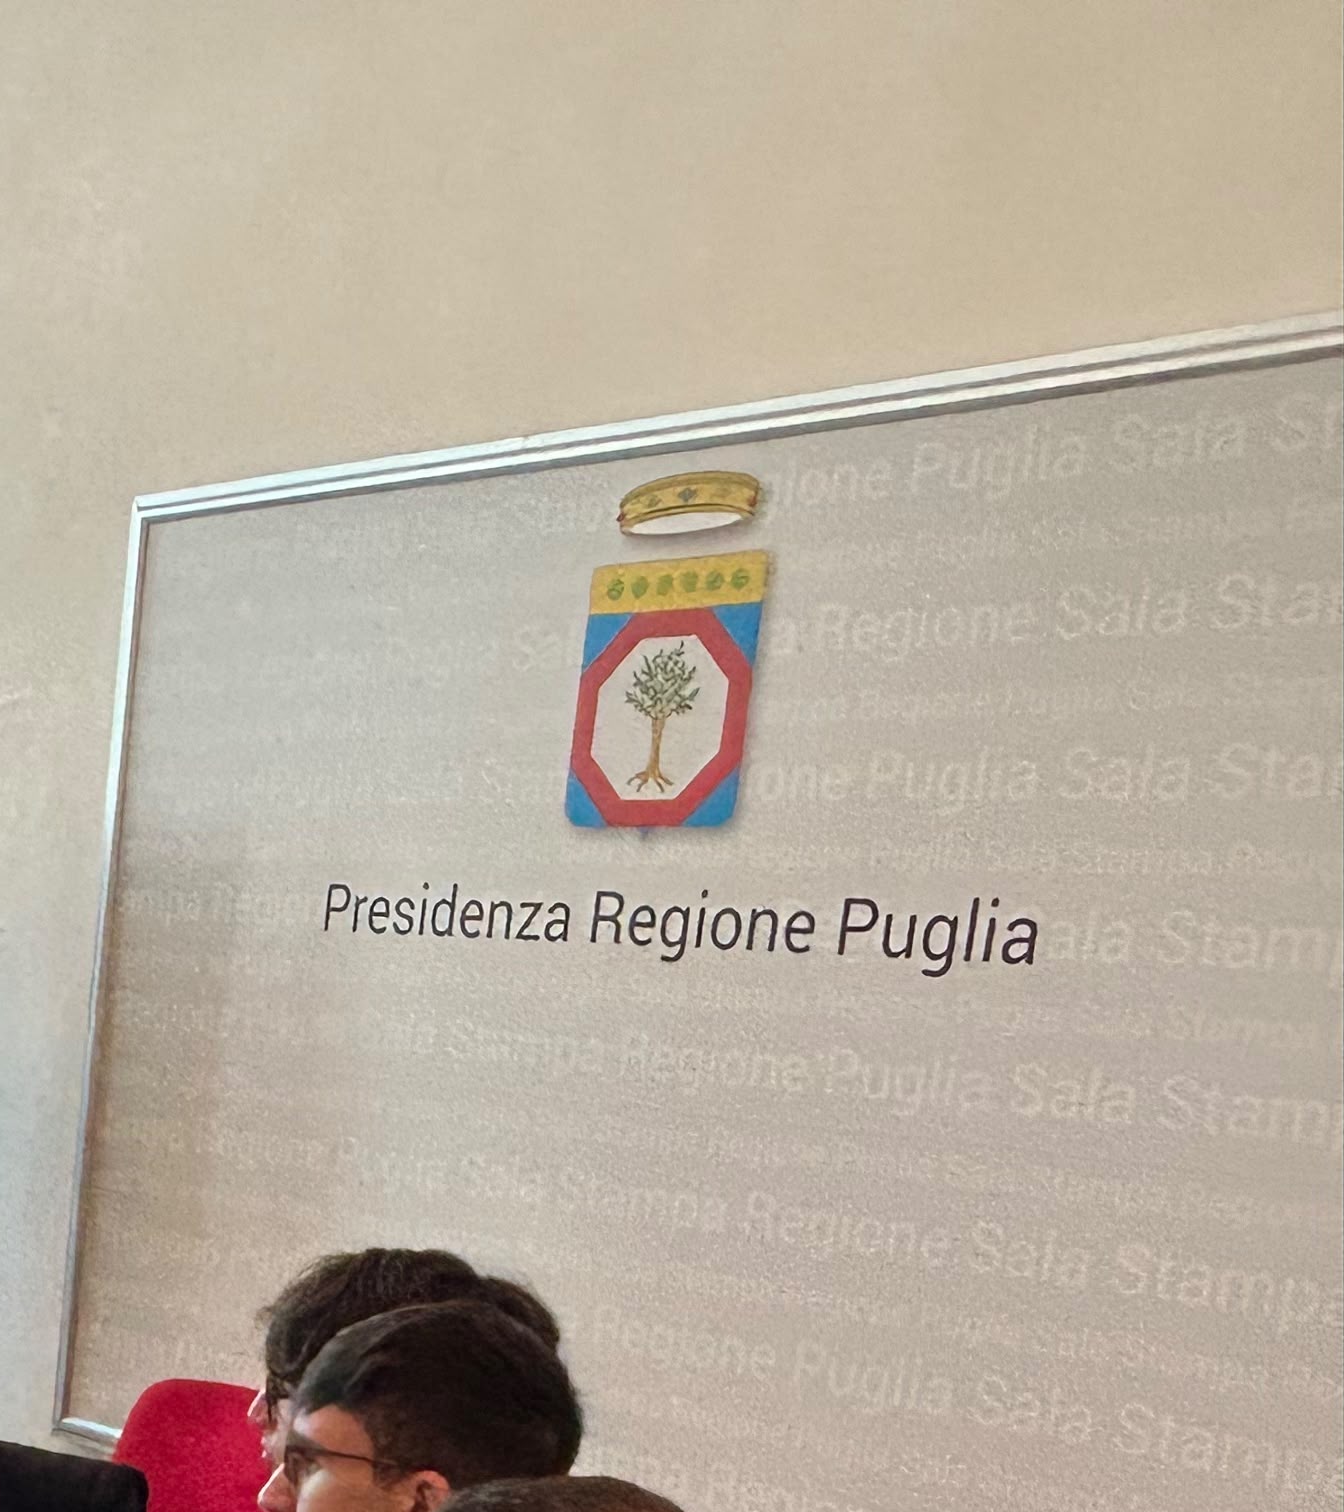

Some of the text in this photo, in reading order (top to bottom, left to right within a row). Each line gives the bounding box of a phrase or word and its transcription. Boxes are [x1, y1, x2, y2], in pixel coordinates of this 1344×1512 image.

[910, 422, 1089, 503] Puglia
[1110, 404, 1249, 475] Sala
[813, 592, 1037, 665] Regione
[1054, 572, 1190, 642] Sala
[865, 745, 1039, 817] Puglia
[1057, 743, 1193, 801] Sala
[324, 882, 571, 943] Presidenza
[589, 889, 816, 963] Regione
[837, 897, 1038, 978] Puglia
[1045, 902, 1135, 966] ala
[823, 1046, 998, 1118] Puglia
[1011, 1061, 1137, 1124] Sala
[742, 1189, 953, 1268] Regione
[967, 1219, 1091, 1290] Sala
[791, 1337, 955, 1419] Puglia
[972, 1371, 1094, 1445] Sala
